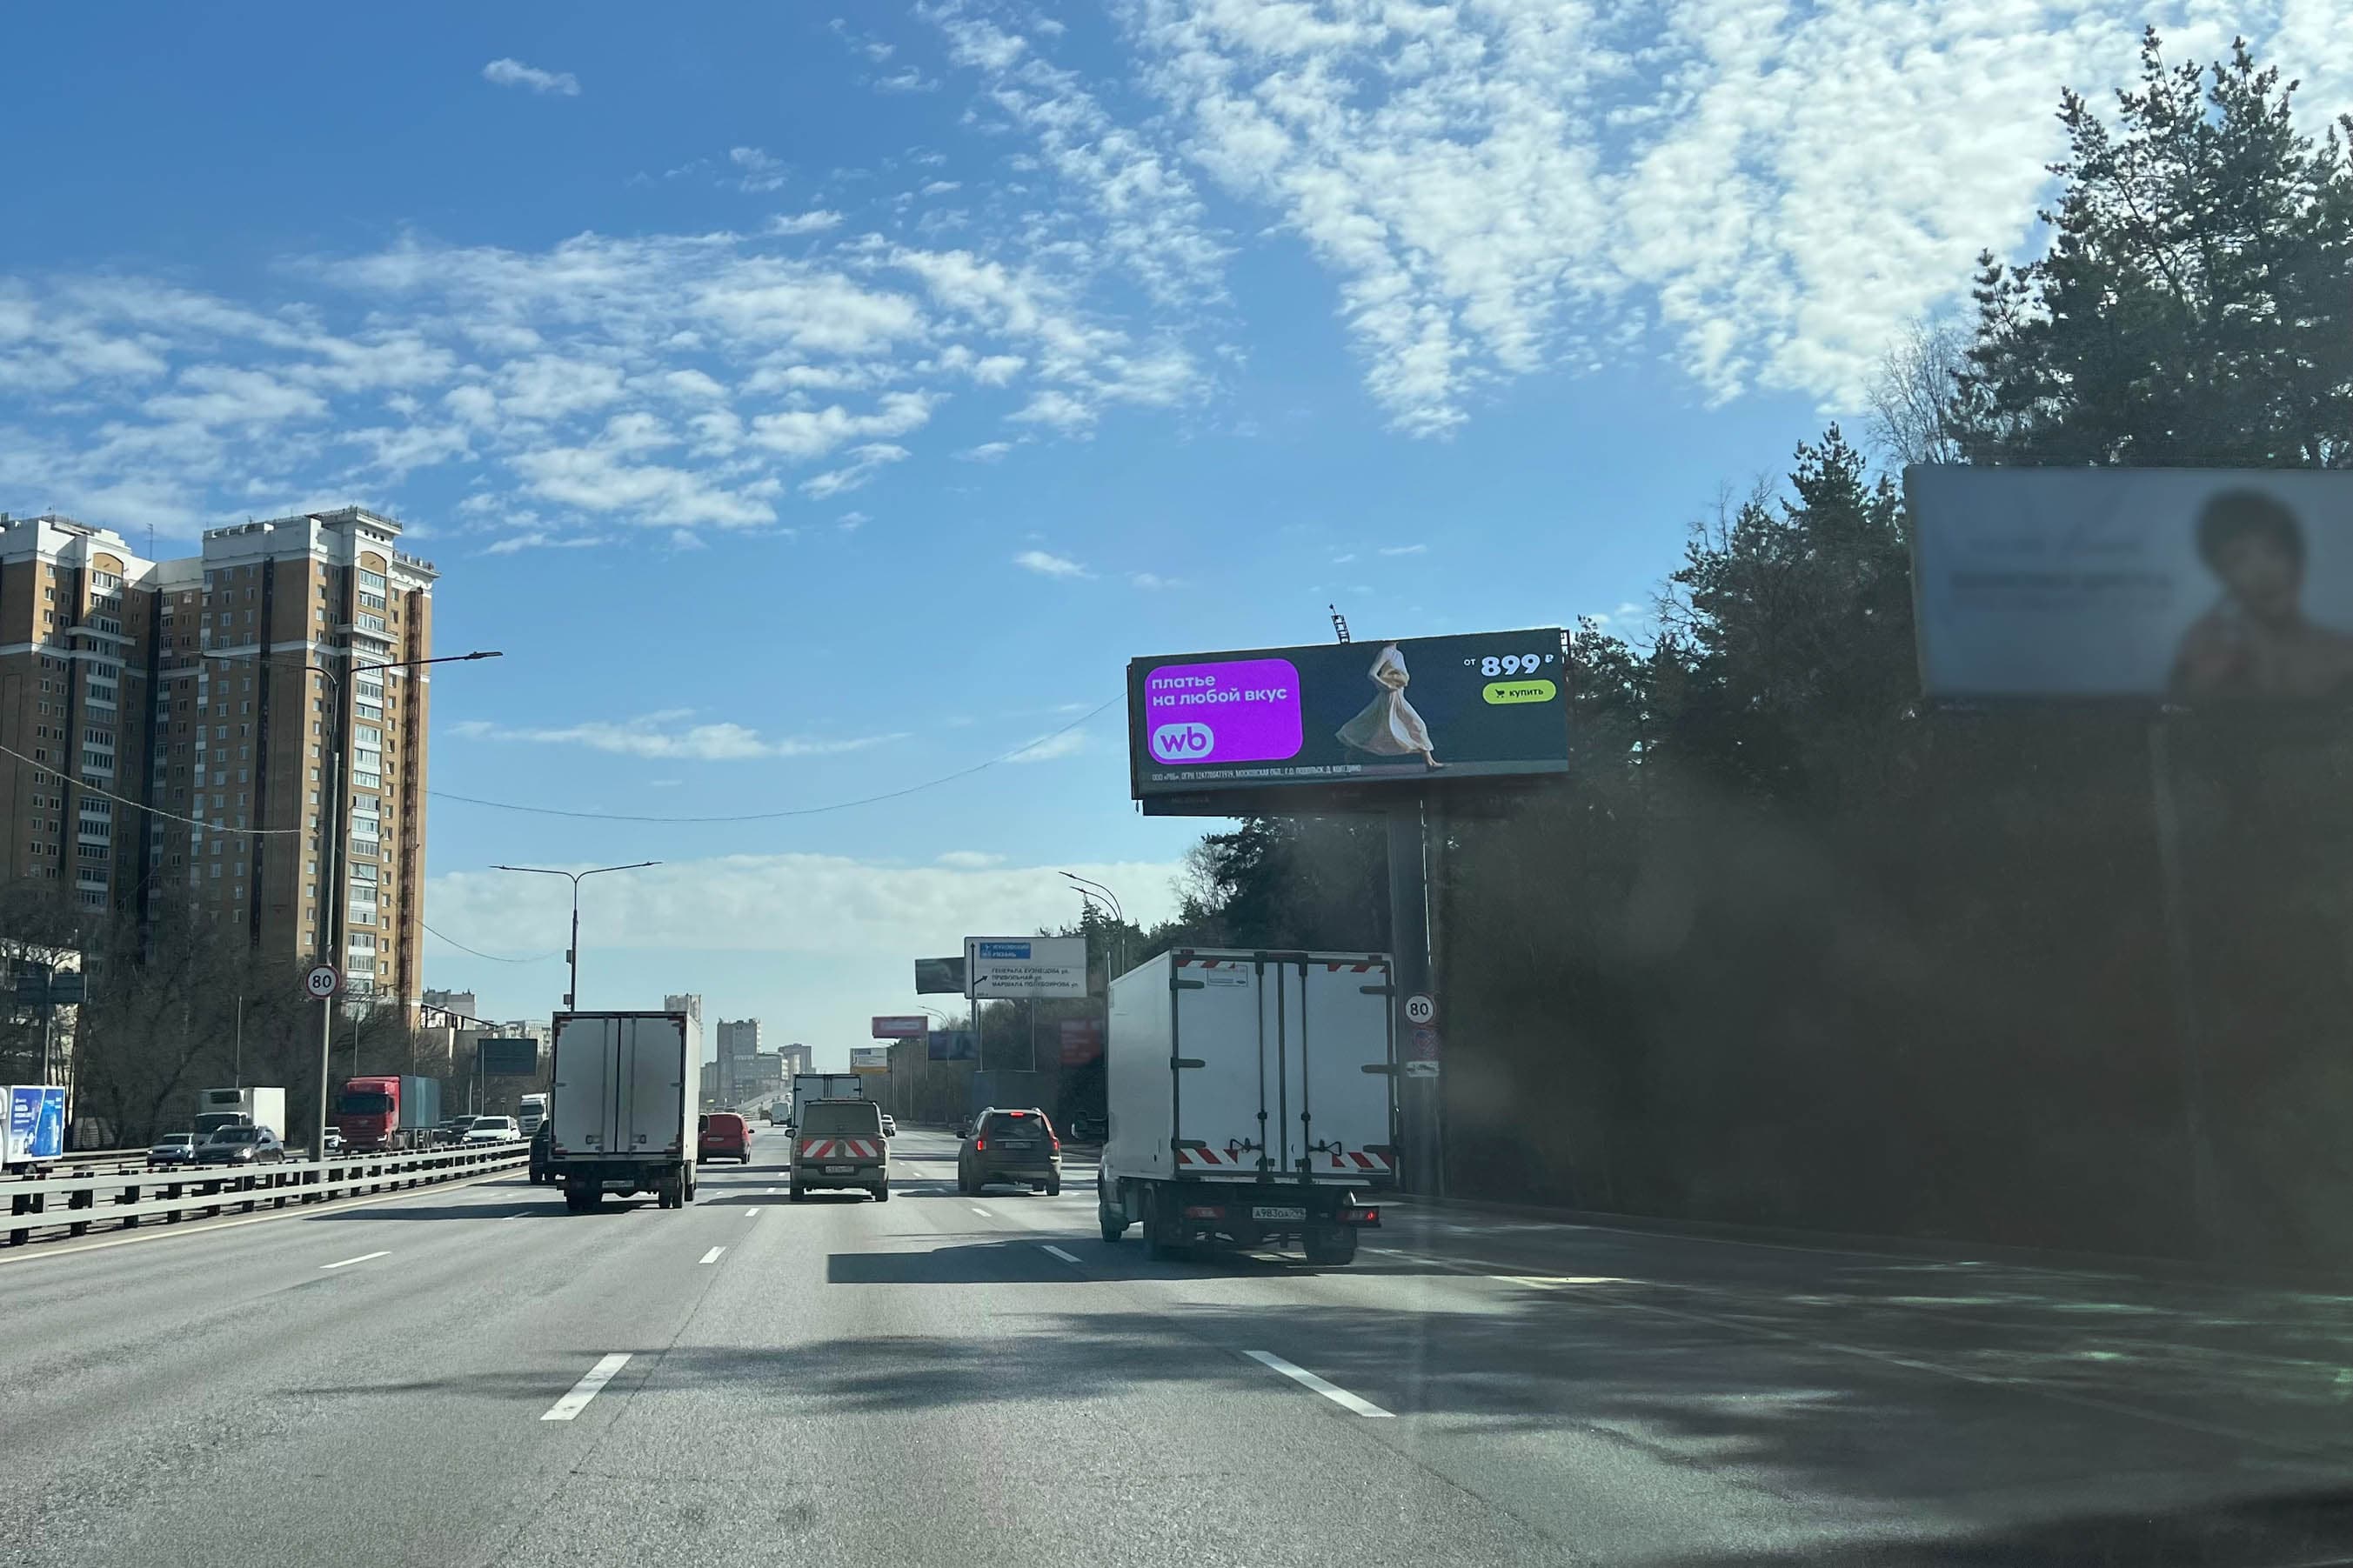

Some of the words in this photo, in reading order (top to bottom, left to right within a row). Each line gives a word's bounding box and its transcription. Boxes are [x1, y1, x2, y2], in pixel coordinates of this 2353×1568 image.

[1481, 653, 1541, 677] 899
[1152, 676, 1216, 690] платье
[1153, 695, 1175, 706] на
[1180, 688, 1240, 705] любой
[1245, 688, 1288, 703] вкус
[1509, 689, 1544, 698] купить
[1160, 726, 1207, 752] wb
[312, 975, 331, 988] 80
[1410, 1003, 1428, 1016] 80
